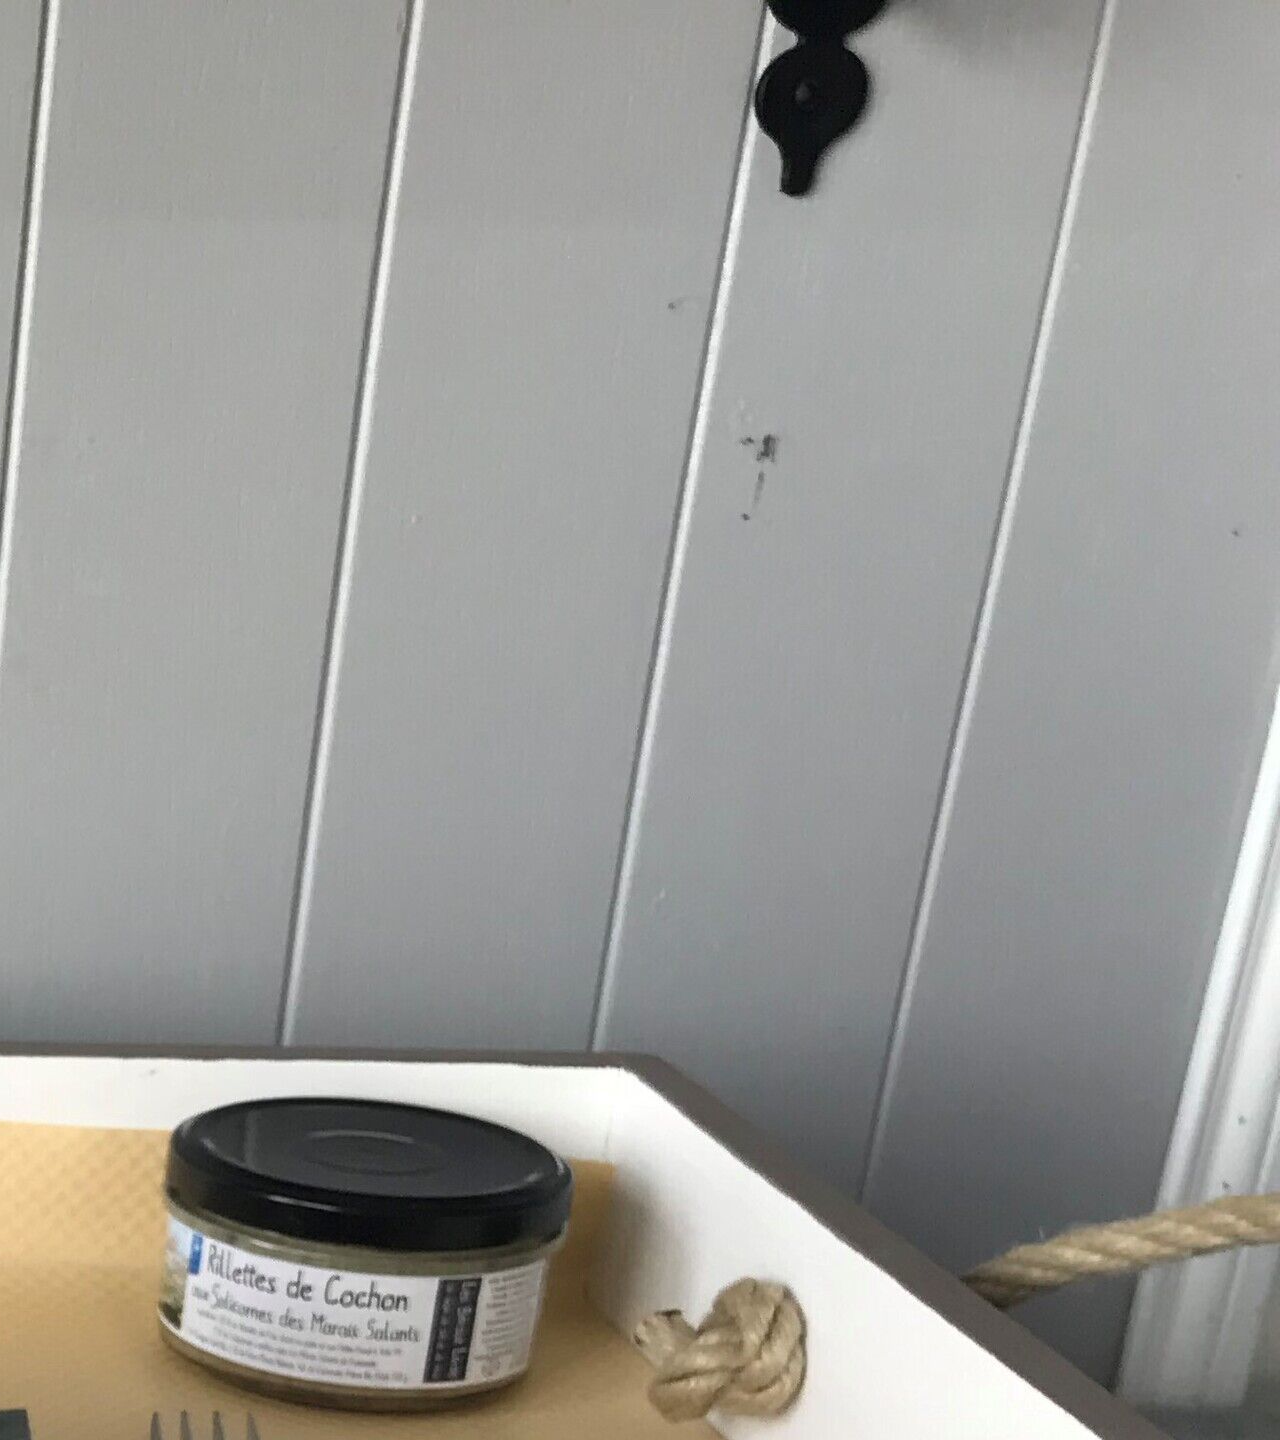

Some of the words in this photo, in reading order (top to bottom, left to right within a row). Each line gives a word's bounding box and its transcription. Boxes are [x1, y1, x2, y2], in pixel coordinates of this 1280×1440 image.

[207, 1244, 277, 1294] Rillettes
[286, 1270, 312, 1301] de
[324, 1275, 409, 1312] Cochon
[278, 1307, 304, 1332] des
